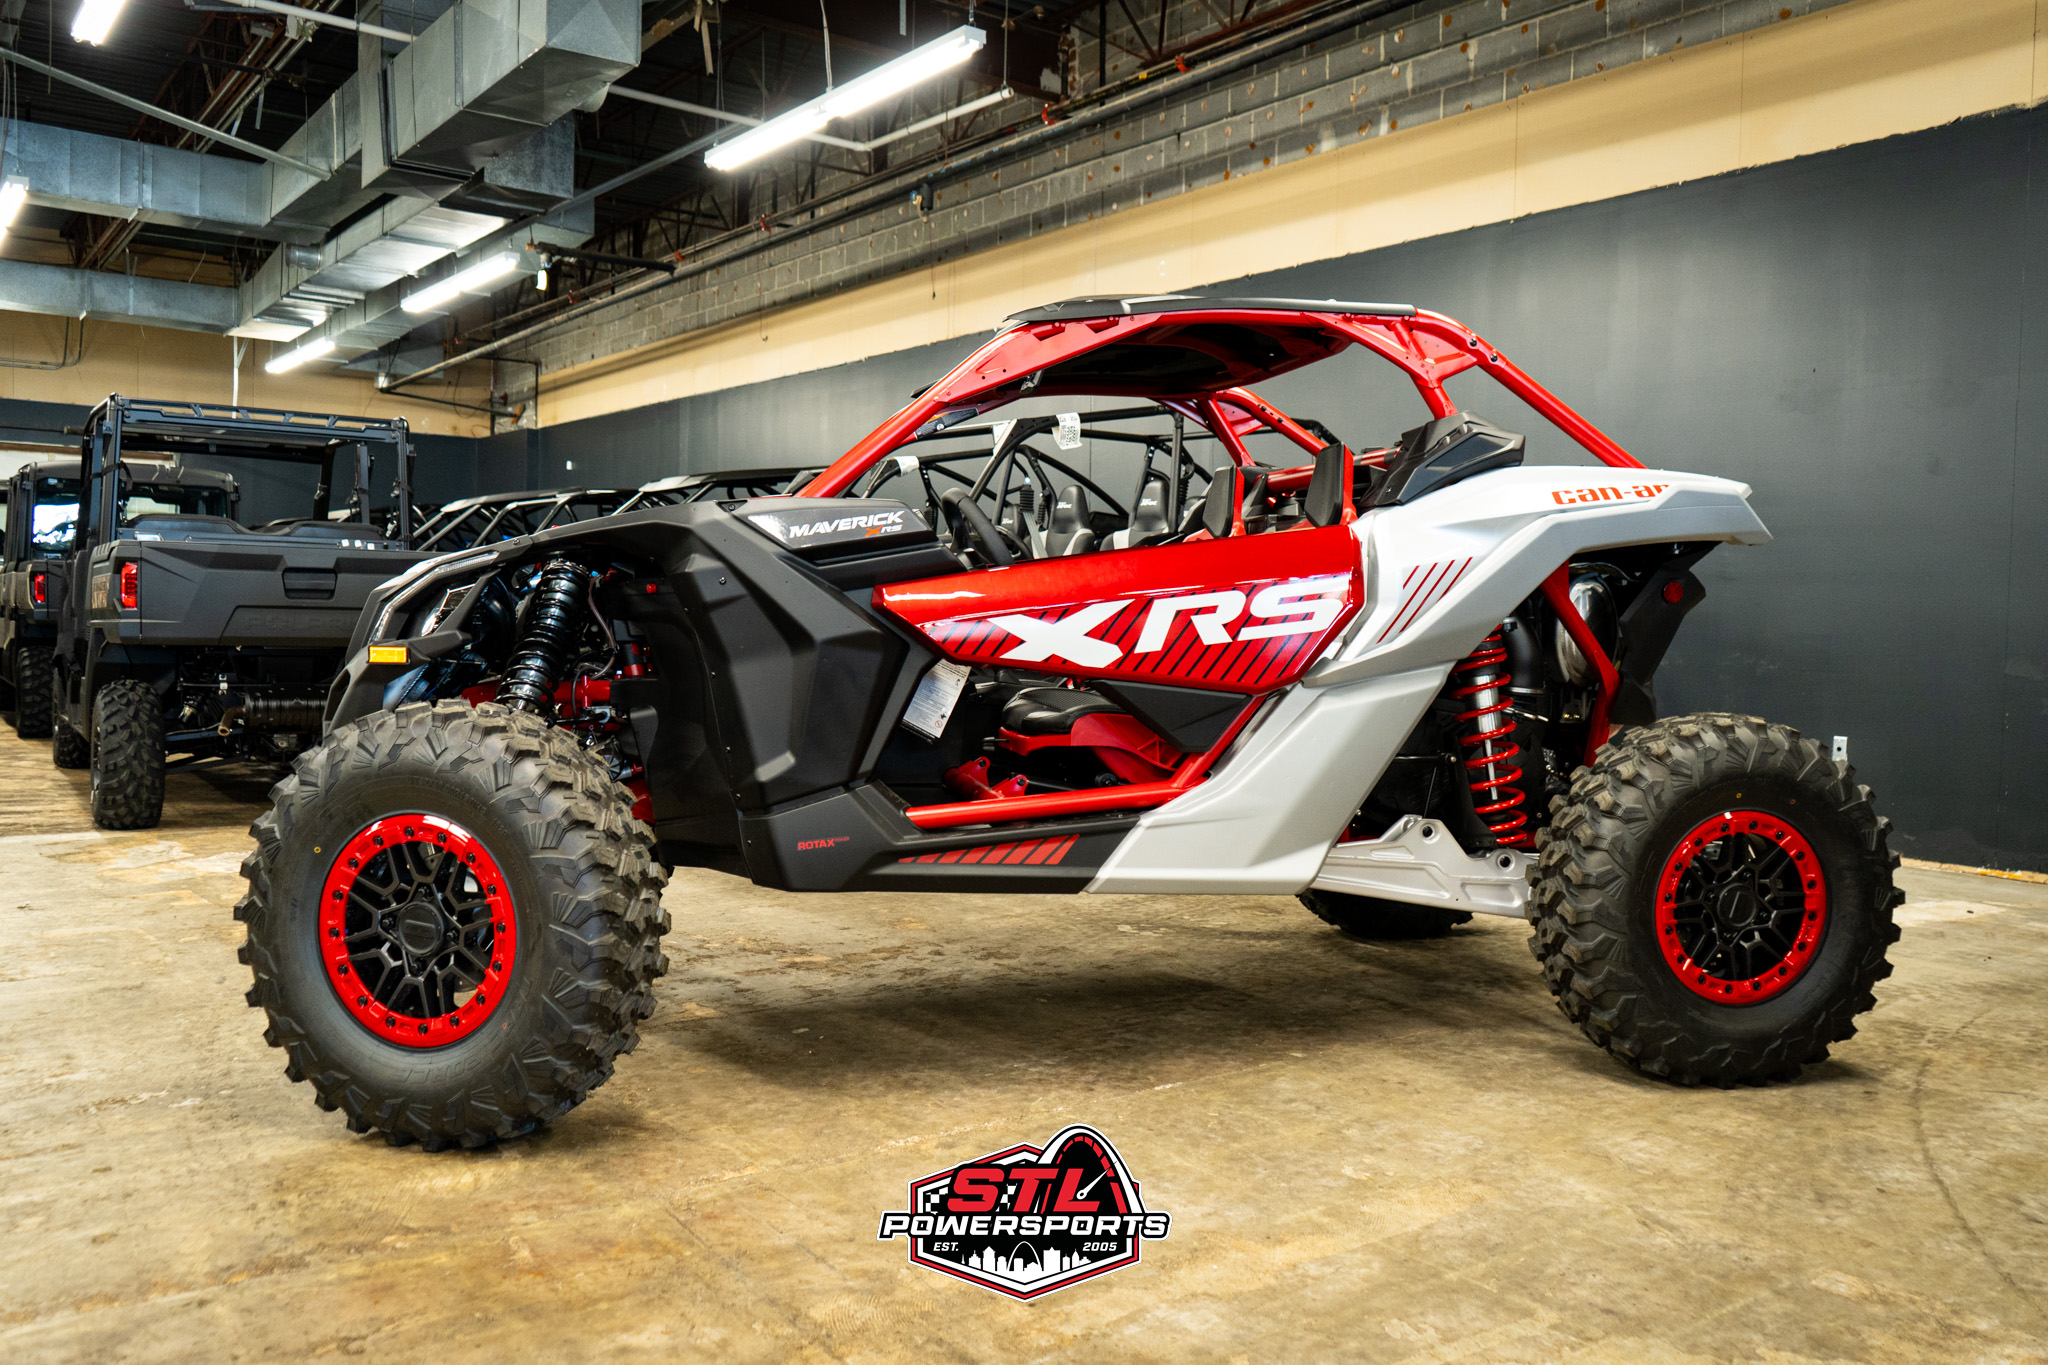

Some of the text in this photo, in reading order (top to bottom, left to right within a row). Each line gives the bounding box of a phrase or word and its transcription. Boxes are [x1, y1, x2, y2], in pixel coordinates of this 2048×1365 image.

[789, 511, 905, 538] MAVERICK
[864, 524, 903, 538] XRS
[988, 572, 1350, 668] XRS
[798, 839, 835, 851] ROTAX
